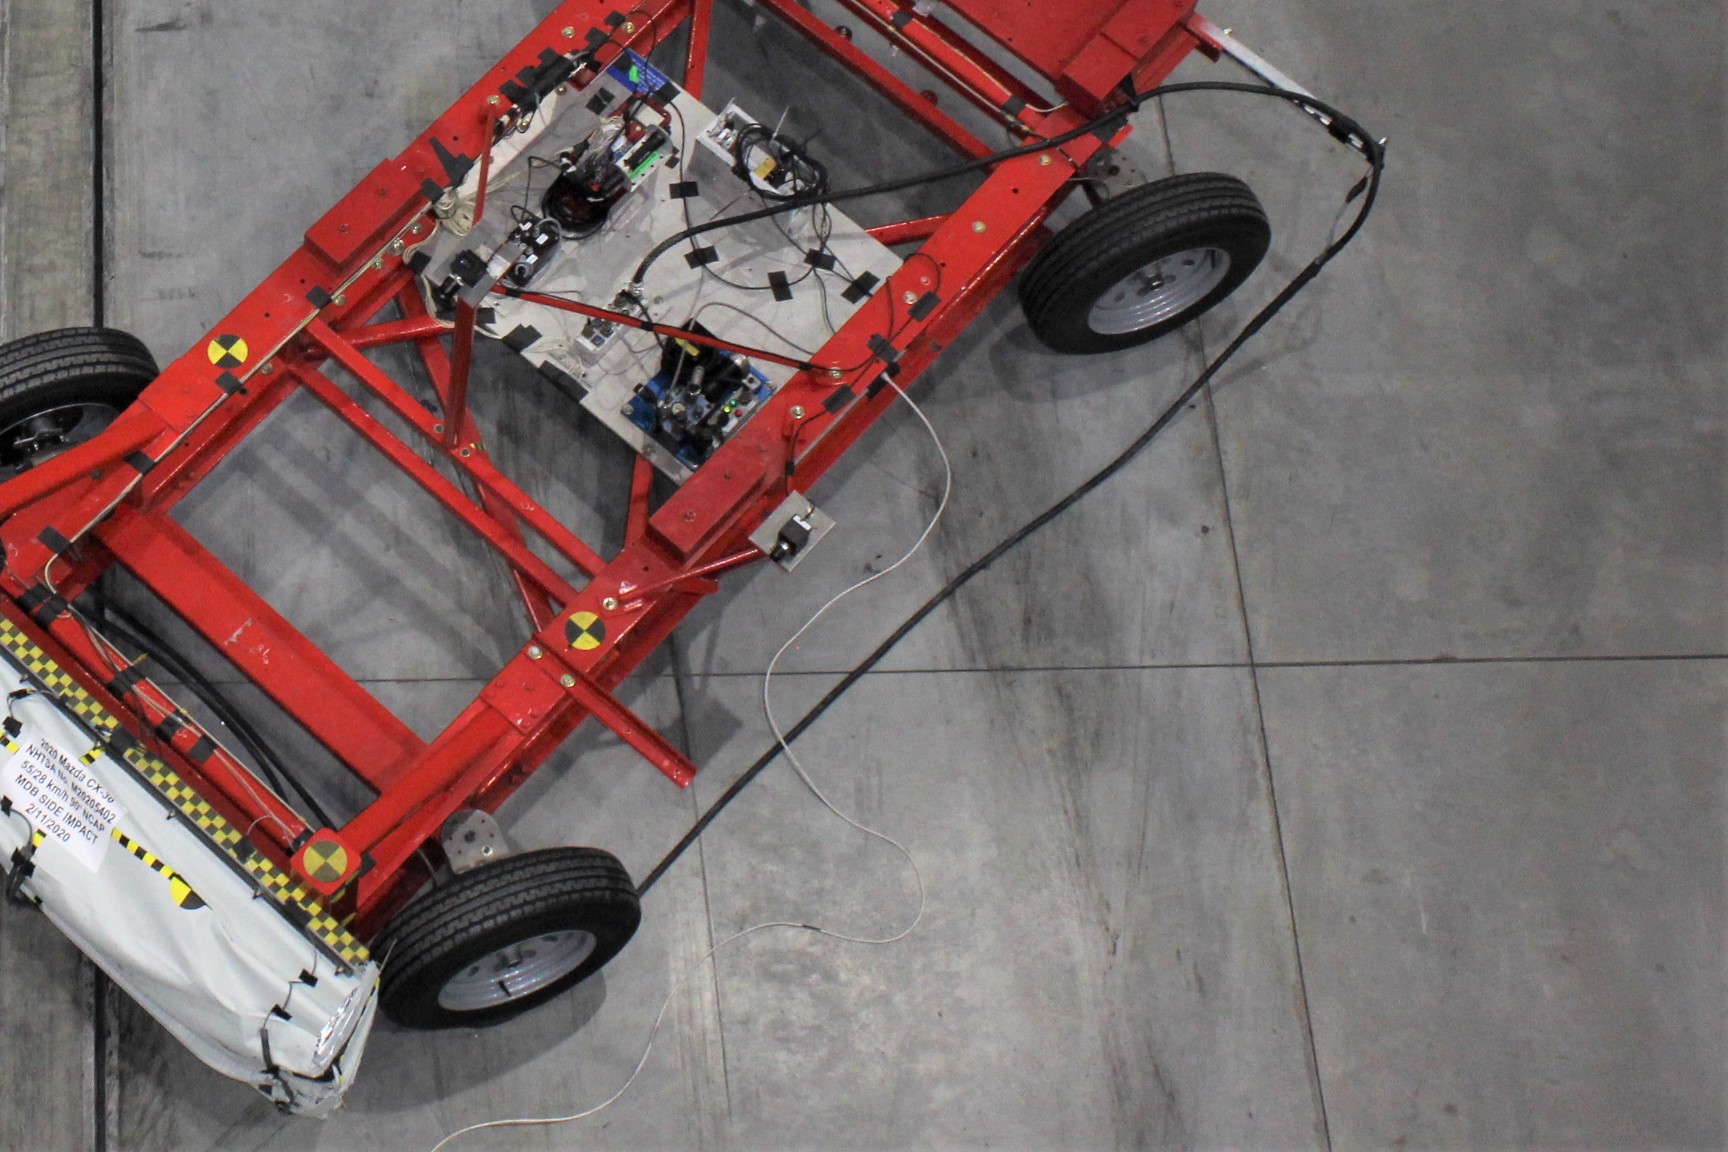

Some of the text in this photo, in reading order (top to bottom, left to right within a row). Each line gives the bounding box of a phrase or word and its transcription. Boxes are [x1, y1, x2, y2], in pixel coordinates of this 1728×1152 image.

[21, 761, 47, 784] 55/28
[46, 780, 69, 802] km/h
[83, 809, 105, 832] NCAP
[26, 744, 57, 773] NHTSA
[71, 782, 116, 824] M20205402
[40, 738, 114, 803] 2020 Mazda CX-30
[15, 774, 99, 844] MDB SIDE IMPACT
[25, 803, 71, 842] 2/11/2020
